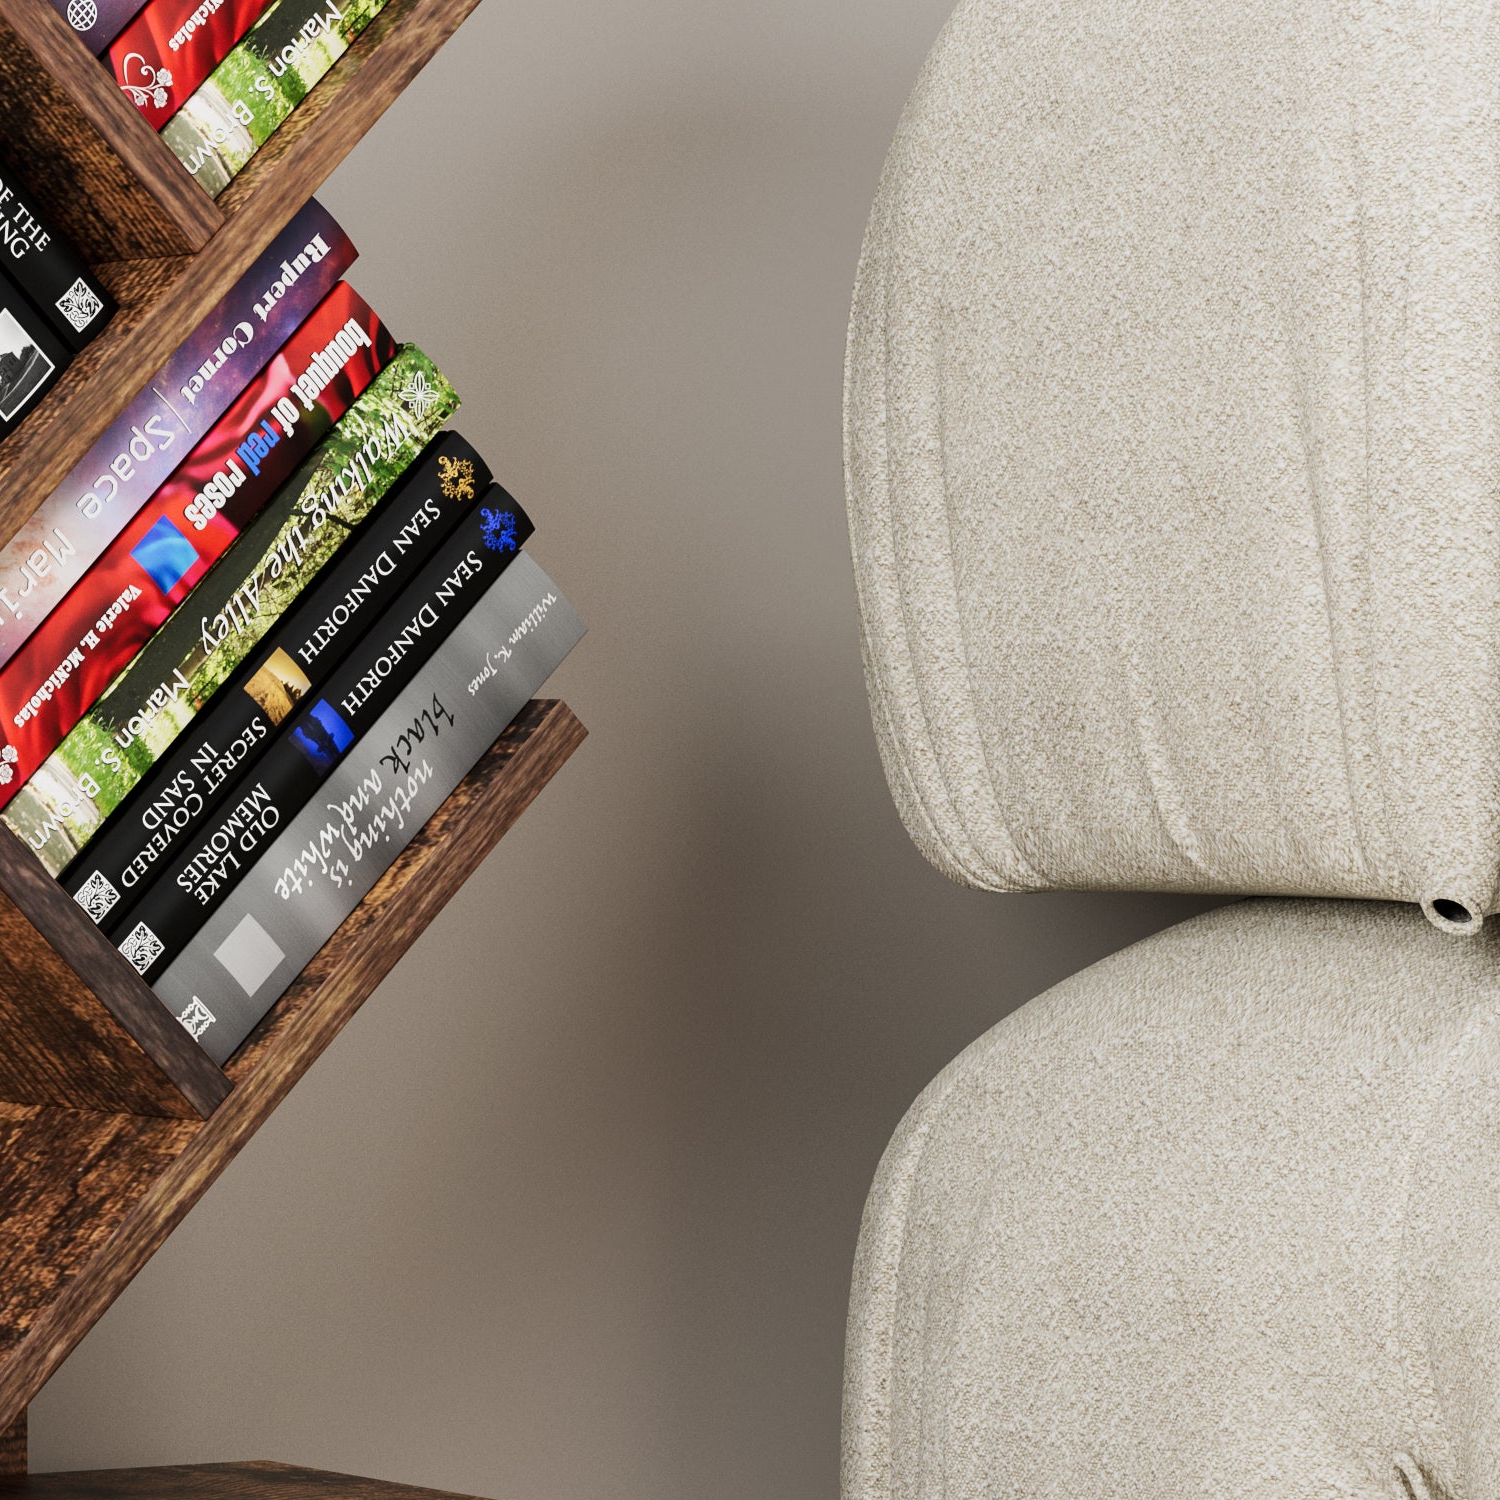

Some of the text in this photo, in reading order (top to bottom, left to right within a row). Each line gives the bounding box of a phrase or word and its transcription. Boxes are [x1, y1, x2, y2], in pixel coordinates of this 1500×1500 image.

[182, 0, 343, 176] Marion S. Brown
[12, 202, 51, 252] THE
[179, 231, 332, 405] Rupert Cornet
[75, 414, 177, 520] Space
[183, 317, 373, 531] bouquet of red roses
[200, 411, 412, 656] Walking the Alley
[297, 498, 442, 665] SEAN DANFORTH
[12, 583, 143, 728] Valerie H. McNicholas
[340, 550, 483, 717] SEAN DANFORTH
[467, 592, 558, 696] William K. Jones
[27, 667, 191, 851] Marion S. Brown
[120, 715, 268, 888] SECRET COVERED
[142, 741, 219, 830] IN SAND
[175, 782, 273, 894] MEMORIES
[274, 692, 455, 901] black and white
[329, 759, 434, 889] nothing is
[194, 805, 280, 906] OLD LAKE
